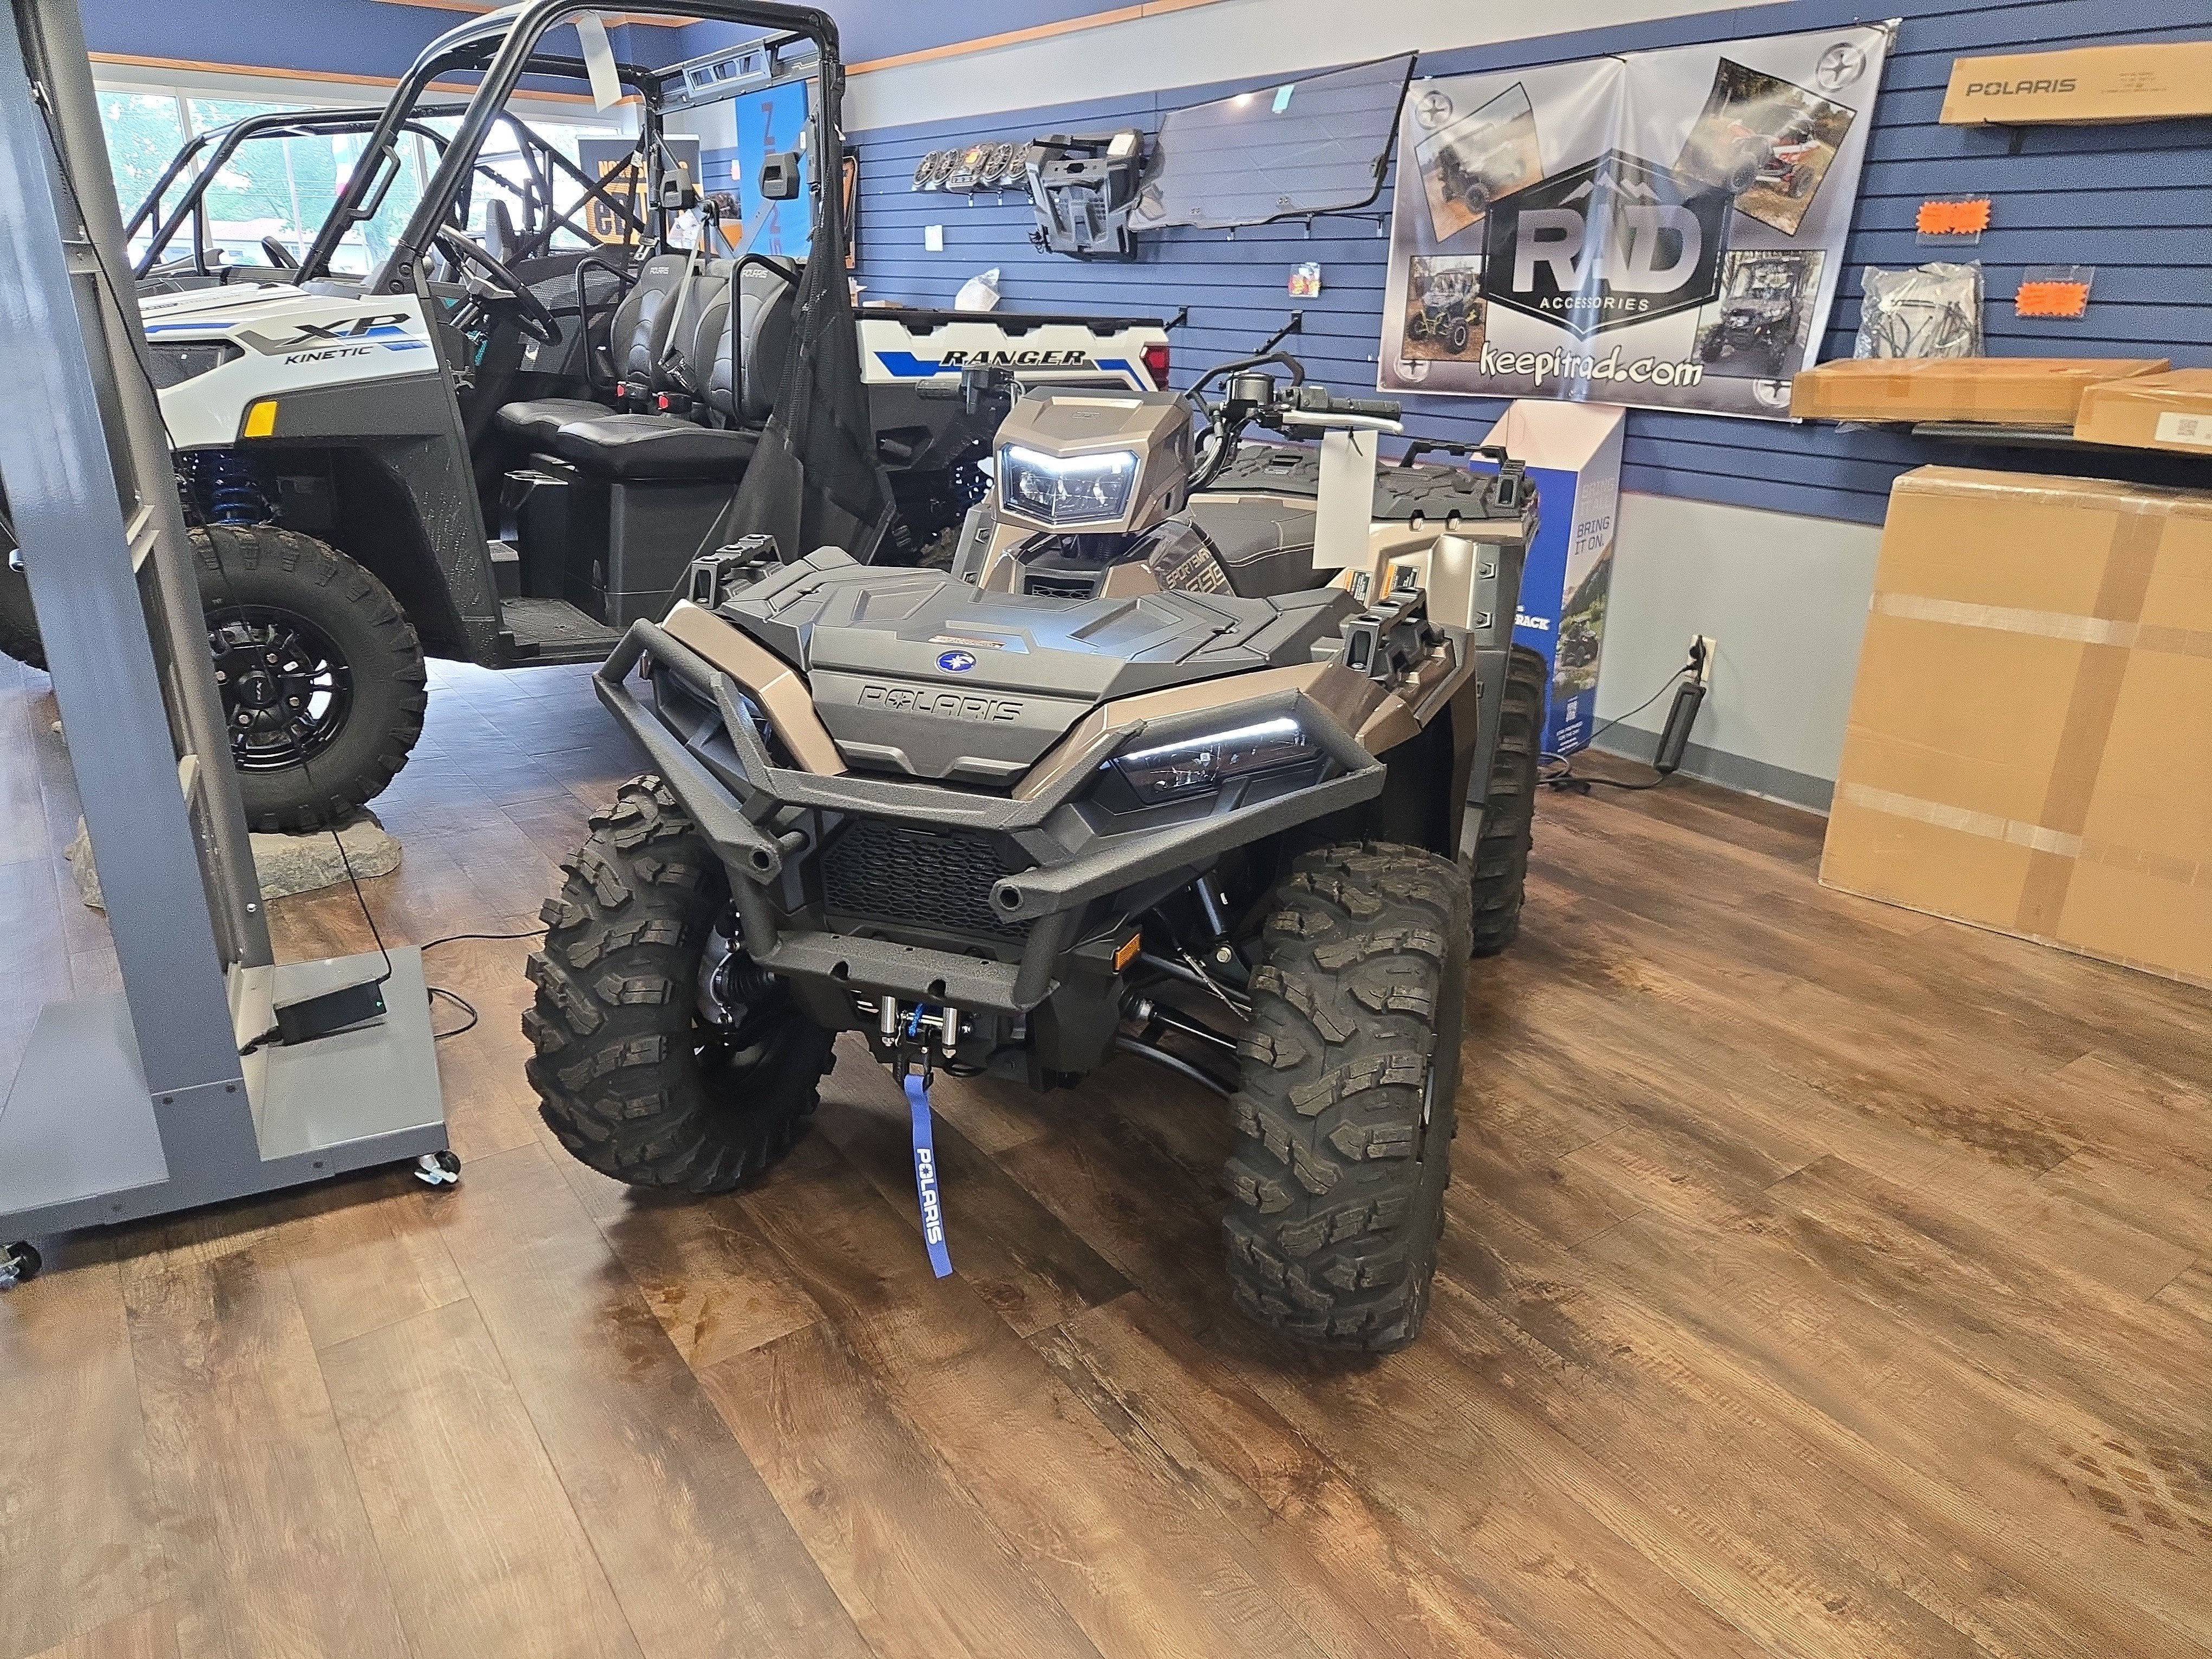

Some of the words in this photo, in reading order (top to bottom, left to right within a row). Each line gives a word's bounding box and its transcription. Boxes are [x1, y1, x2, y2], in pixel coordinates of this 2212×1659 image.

[1965, 78, 2076, 97] POLARIS
[1513, 204, 1702, 293] RAD
[1539, 296, 1650, 312] ACCESSORIES
[275, 313, 412, 348] XP
[284, 346, 374, 365] KINETIC
[939, 350, 1086, 367] RANGER
[1480, 340, 1705, 387] keepitrad.com
[1577, 516, 1610, 538] BRING
[1574, 538, 1587, 555] IT
[1514, 613, 1551, 631] RACK
[857, 685, 1024, 723] POLARIS
[916, 1148, 943, 1245] POLARIS
